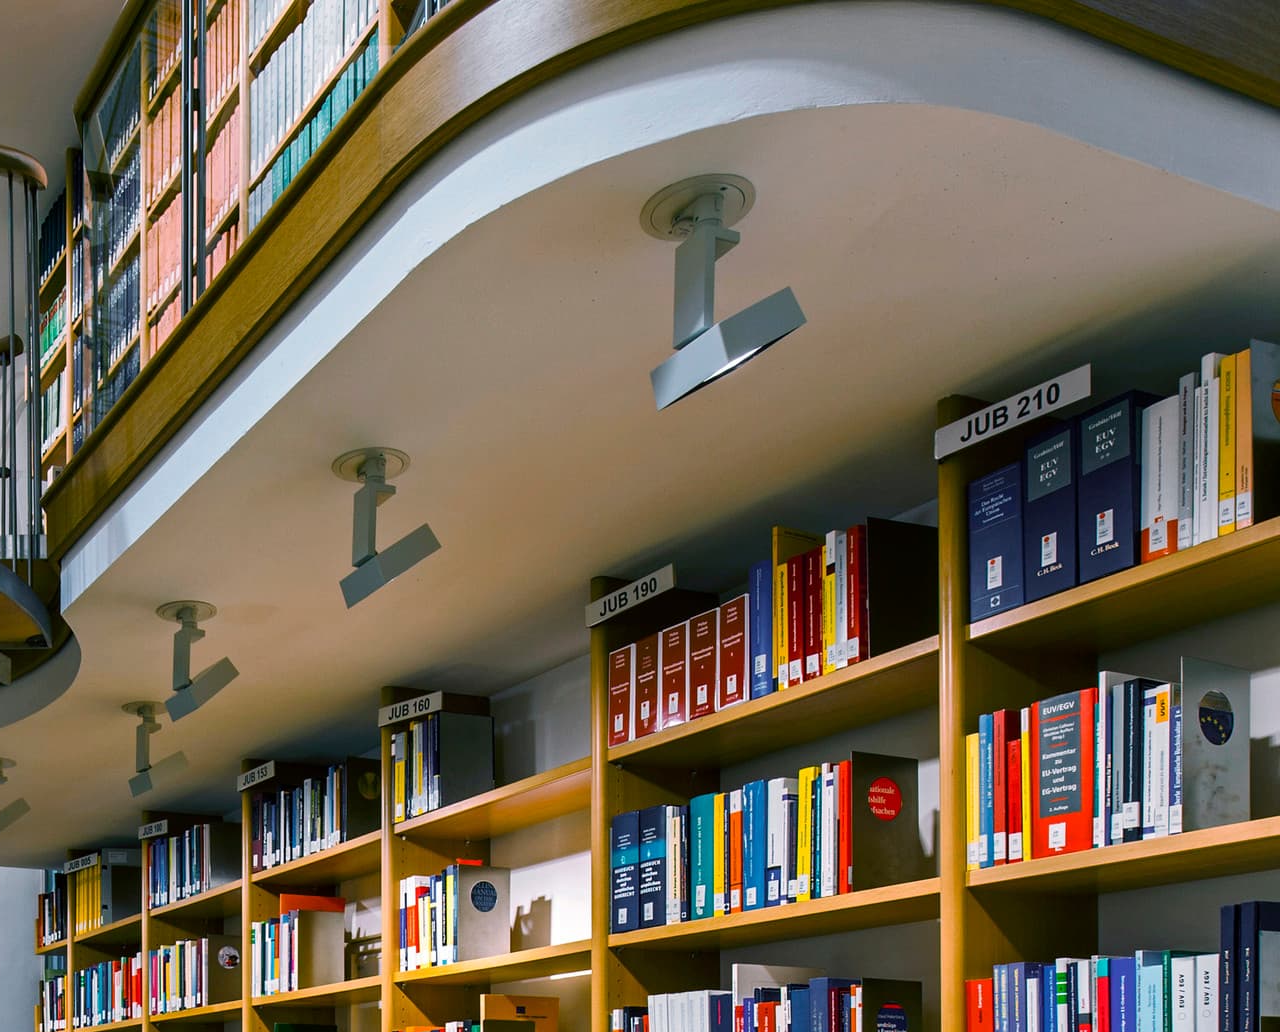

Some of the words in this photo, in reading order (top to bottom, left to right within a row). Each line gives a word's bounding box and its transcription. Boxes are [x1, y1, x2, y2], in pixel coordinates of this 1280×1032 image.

[959, 413, 1010, 443] JUB
[1016, 382, 1061, 419] 210
[599, 591, 629, 618] JUB
[633, 576, 659, 601] 190
[388, 703, 410, 721] JUB
[412, 697, 431, 714] 160
[1042, 700, 1075, 716] EUV/EGV
[1042, 747, 1076, 761] Kommentar
[242, 773, 256, 787] JUB
[257, 766, 269, 779] 153
[1042, 764, 1077, 778] EU-Vertrag
[1042, 783, 1077, 796] EG-Vertrag
[142, 825, 153, 836] JUB
[68, 861, 80, 872] JUB
